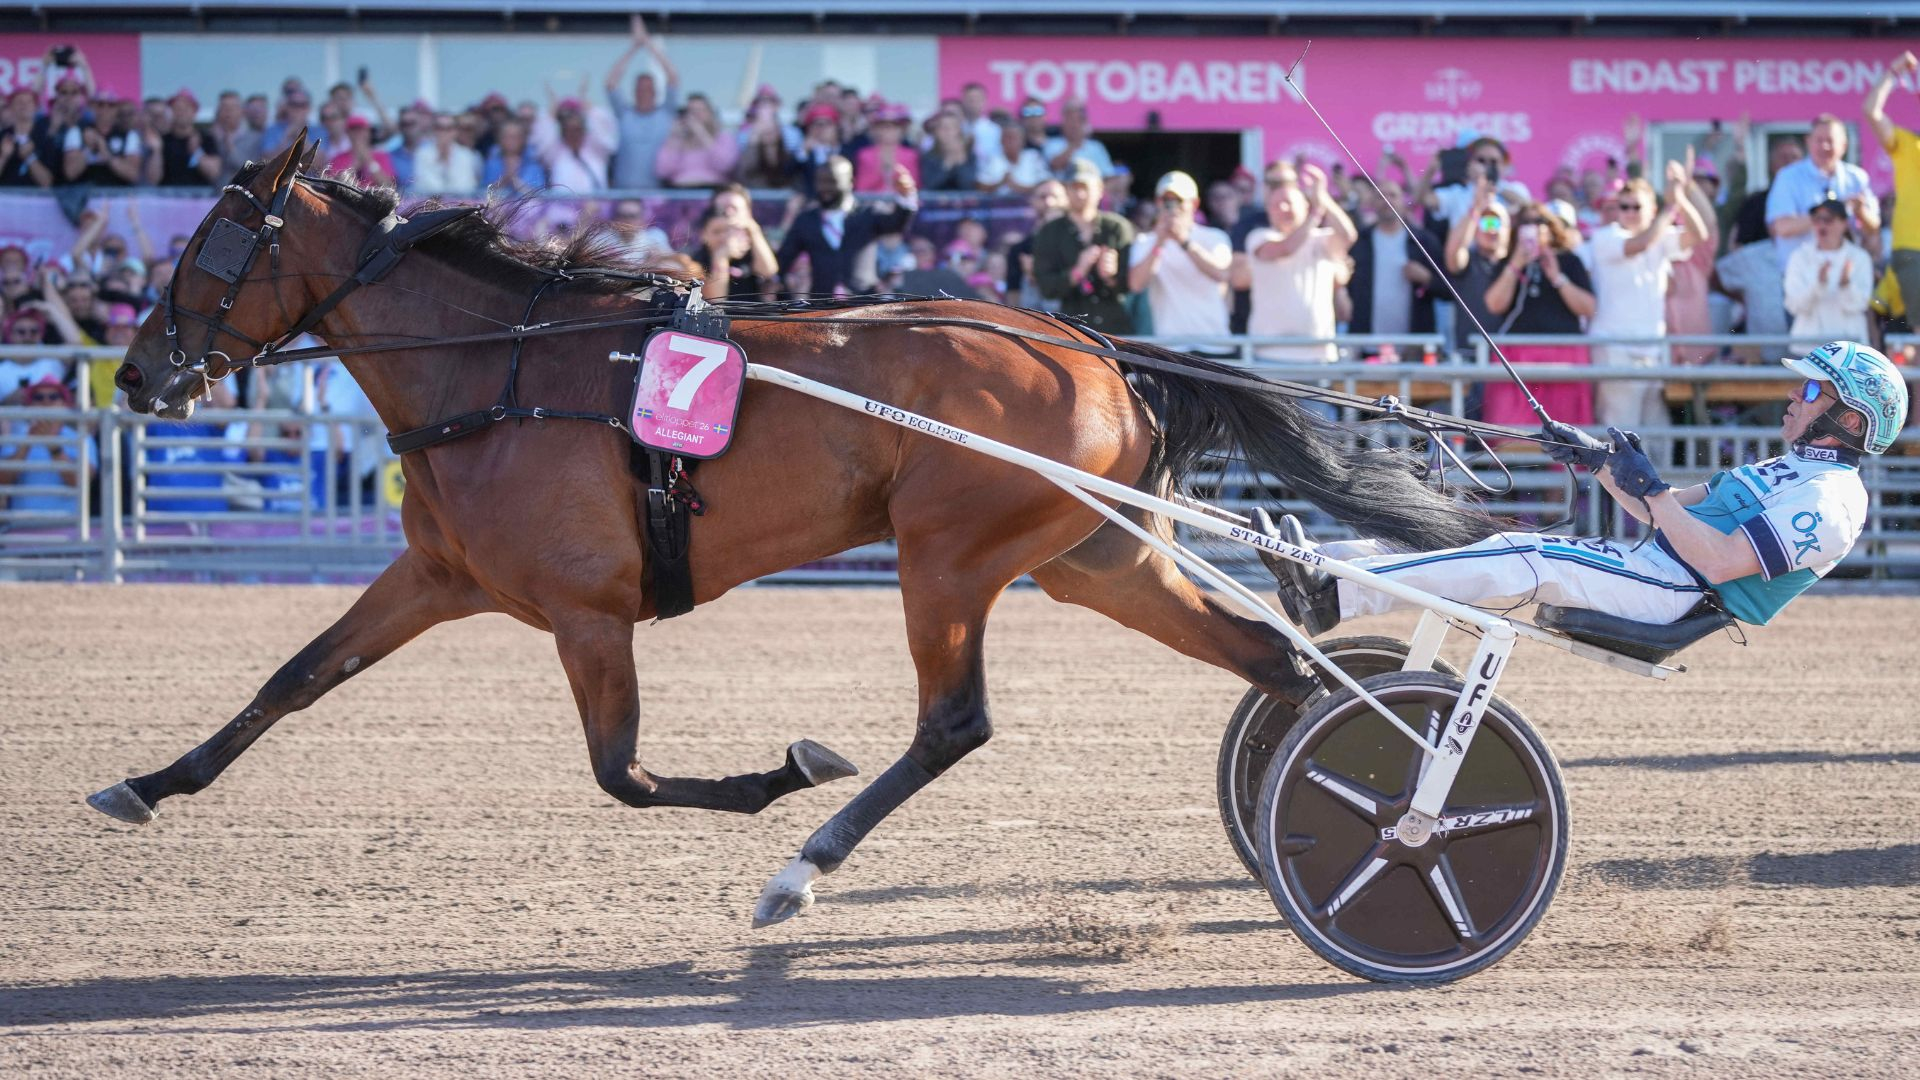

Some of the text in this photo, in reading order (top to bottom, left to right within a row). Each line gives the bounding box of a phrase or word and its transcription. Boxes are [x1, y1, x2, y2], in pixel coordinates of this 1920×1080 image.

[989, 60, 1306, 102] TOTOBAREN
[1570, 59, 1920, 94] ENDAST PERSON
[669, 335, 728, 411] 7
[655, 427, 704, 444] ALLEGIANT
[864, 400, 969, 444] UFO ECLIPSE
[1806, 448, 1836, 460] SVEA
[1230, 526, 1326, 567] STALL ZET
[1791, 511, 1823, 566] ÖK
